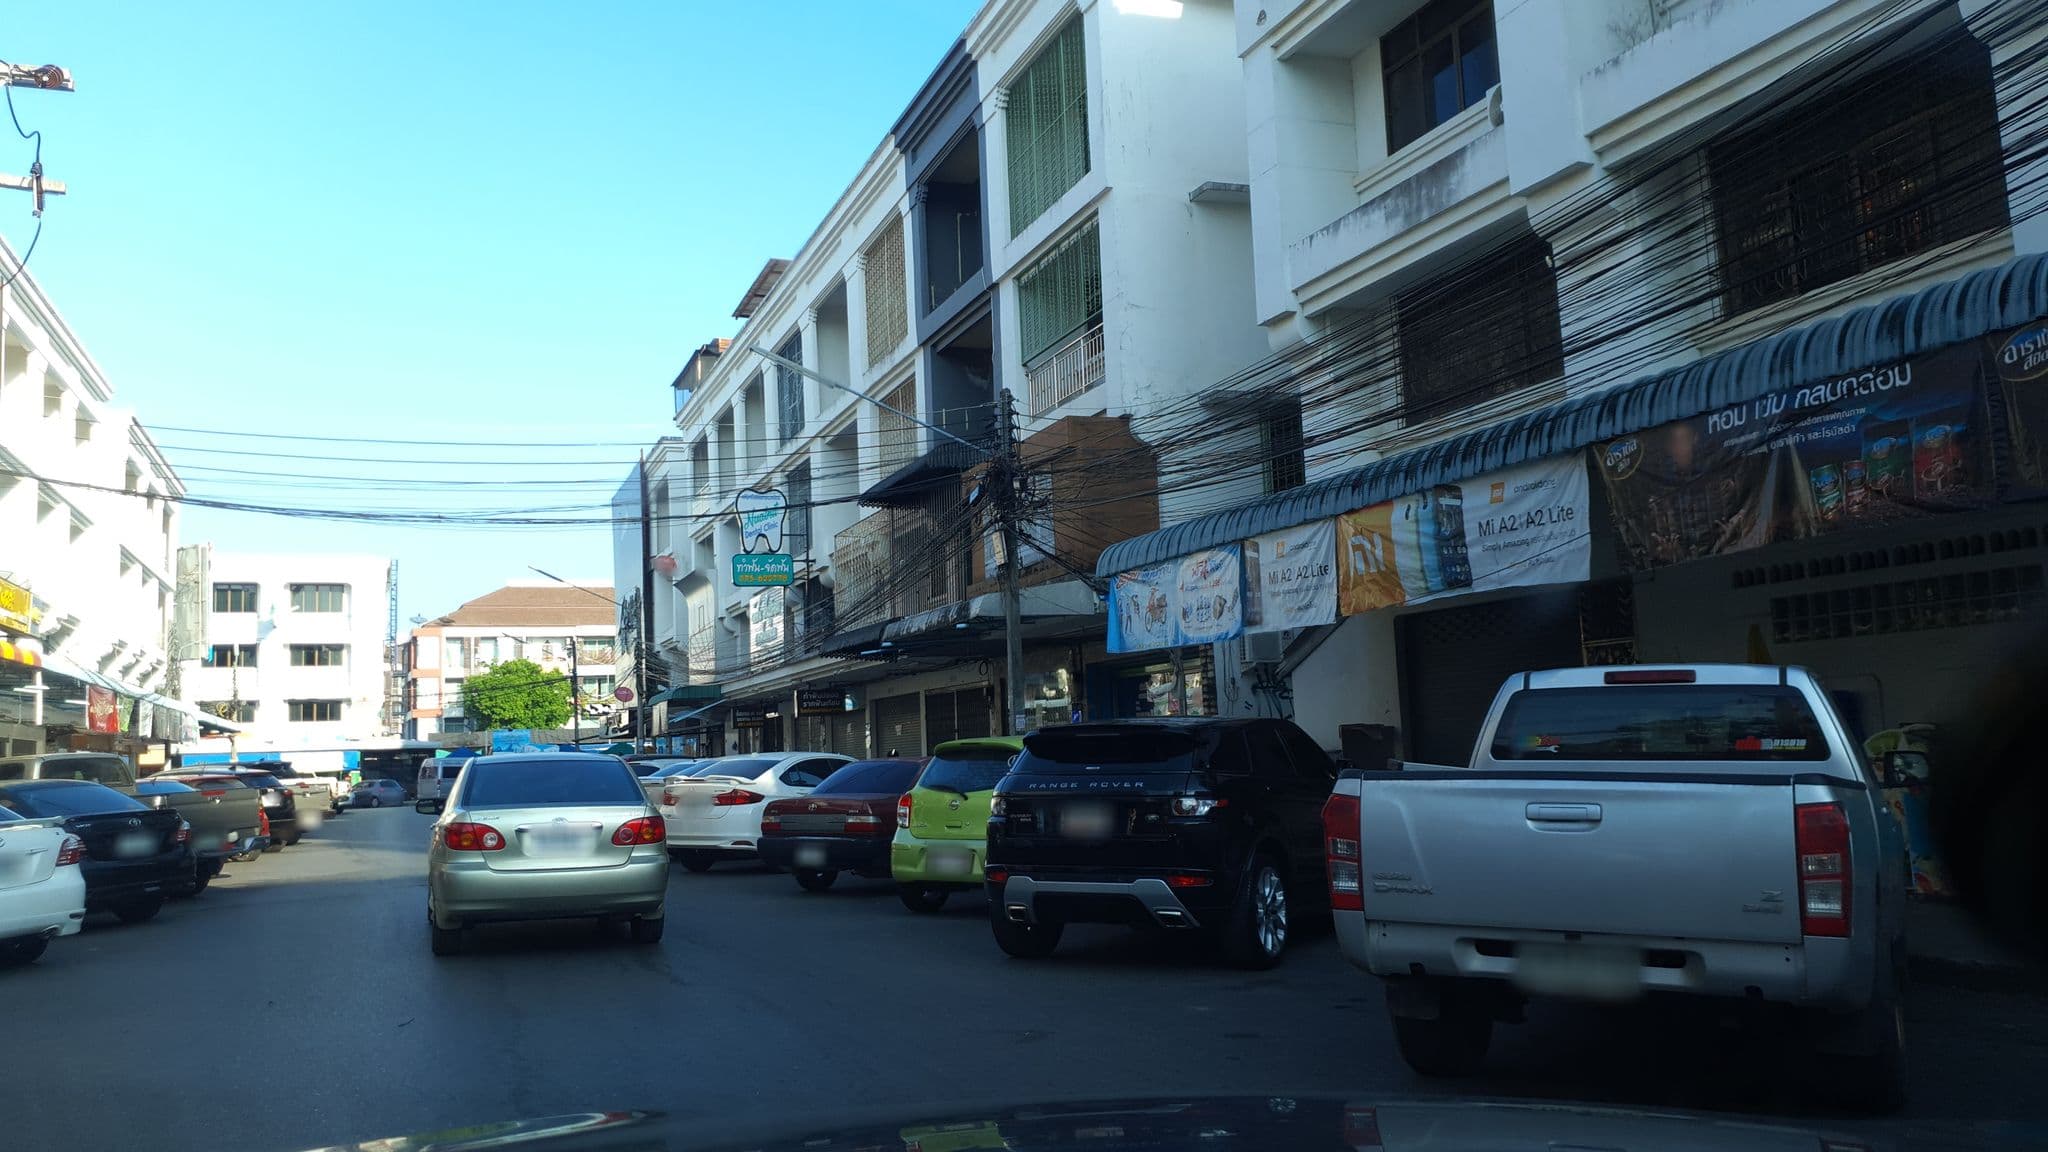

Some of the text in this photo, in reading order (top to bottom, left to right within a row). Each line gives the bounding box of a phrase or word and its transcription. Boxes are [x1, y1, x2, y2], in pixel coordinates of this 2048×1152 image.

[1707, 404, 1747, 434] หอม
[1793, 361, 1912, 409] กลมกล่อม
[763, 521, 779, 531] Clinic
[1478, 505, 1574, 537] Mi A2 A2 Lite
[1268, 562, 1329, 585] Mi A2 A2 Lite
